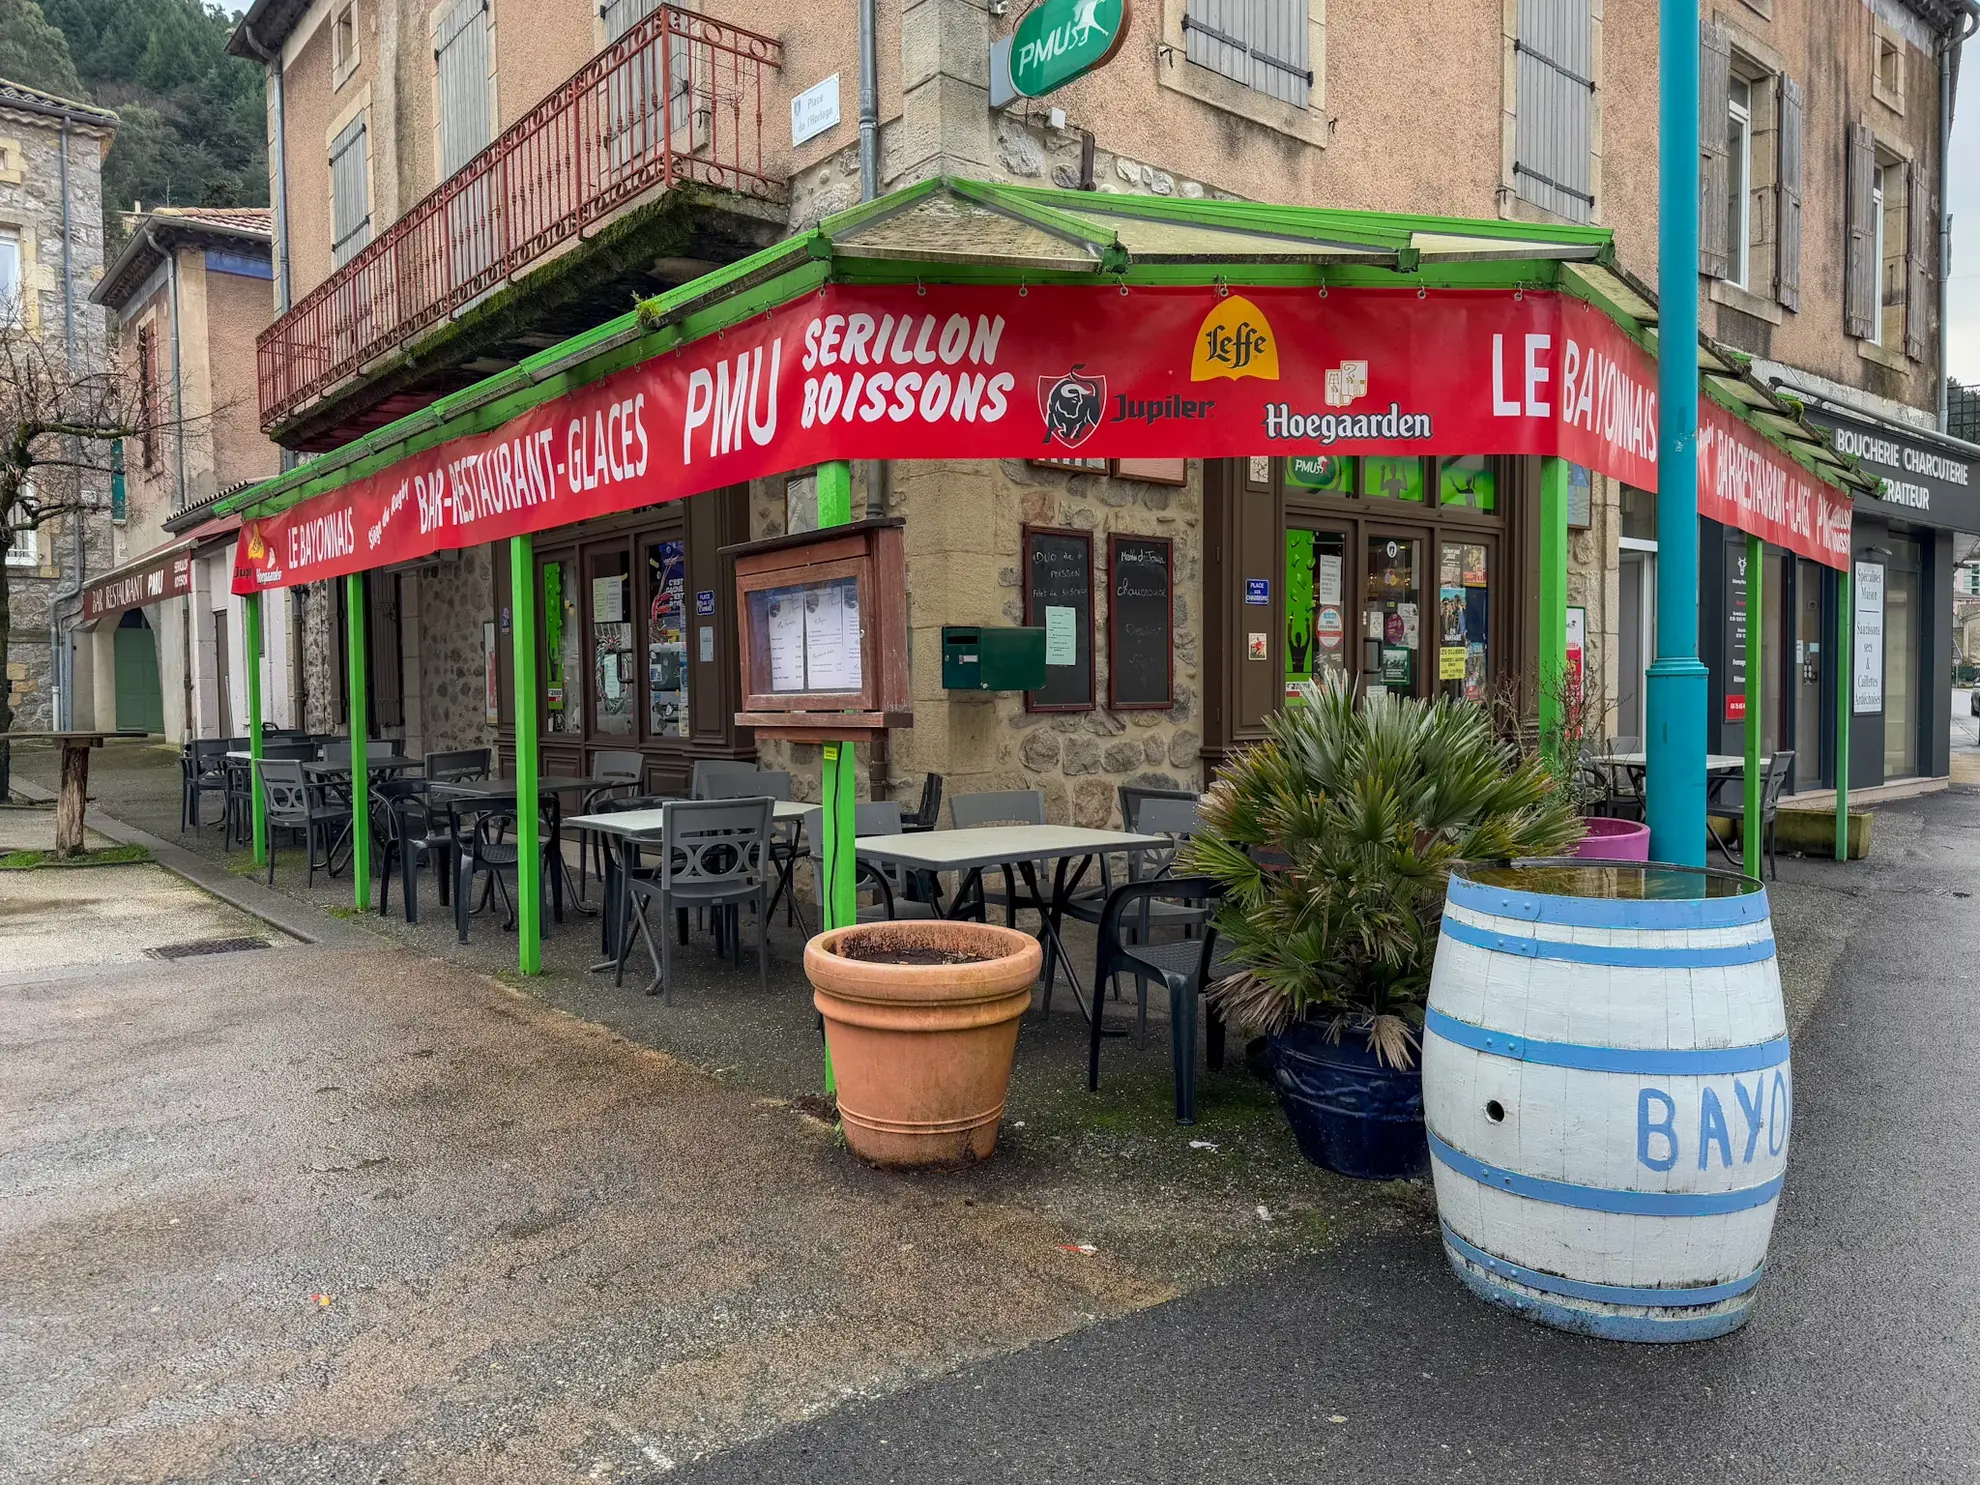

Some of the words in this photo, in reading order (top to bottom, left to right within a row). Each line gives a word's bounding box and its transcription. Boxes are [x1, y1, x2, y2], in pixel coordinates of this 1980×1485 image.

[1018, 20, 1072, 77] PMU
[807, 94, 823, 110] Place
[801, 312, 1005, 372] SERILLON
[1204, 321, 1267, 369] Leffe
[683, 337, 782, 465] PMU
[800, 370, 1015, 430] BOISSONS
[1109, 394, 1216, 425] Jupiler
[1264, 402, 1432, 446] Hoegaarden
[1491, 333, 1551, 418] LE
[1562, 338, 1658, 463] BAYONNAIS
[1295, 459, 1317, 474] PMU
[1835, 428, 1900, 467] BOUCHERIE
[1903, 448, 1968, 485] CHARCUTERIE
[1881, 477, 1930, 510] TRAITEUR
[288, 527, 298, 569] LE
[300, 506, 354, 566] BAYONNAIS
[92, 589, 103, 614] BAR
[105, 574, 143, 610] RESTAURANT
[147, 570, 164, 597] PMU
